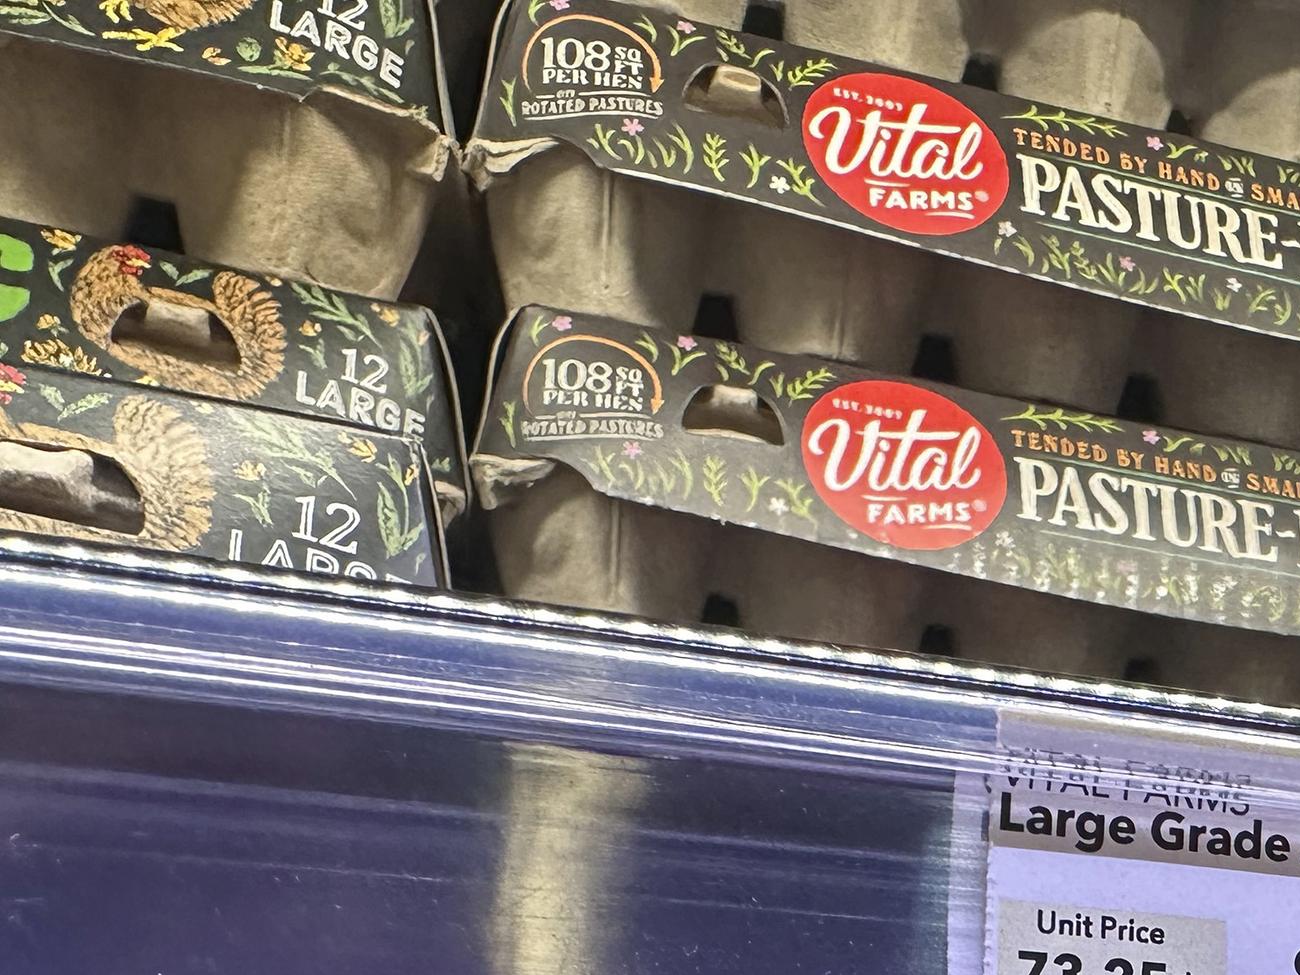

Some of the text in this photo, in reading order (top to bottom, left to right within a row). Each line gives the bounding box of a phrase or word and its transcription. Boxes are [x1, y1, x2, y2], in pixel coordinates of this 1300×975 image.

[270, 0, 405, 89] LARGE
[541, 37, 642, 72] 108 SQ
[614, 60, 643, 75] FT
[542, 69, 643, 89] PER HEN
[521, 96, 664, 116] ROTATED PASTURES
[808, 103, 984, 181] Vital
[1013, 127, 1110, 165] TENDED
[1120, 152, 1148, 174] BY
[1158, 161, 1220, 191] HAND
[341, 348, 390, 394] 12
[542, 358, 643, 393] 108 SQ
[295, 370, 427, 440] LARGE
[543, 390, 589, 407] PER
[808, 409, 982, 492] Vital
[1011, 429, 1108, 462] TENDED
[1116, 448, 1145, 470] BY
[1154, 456, 1217, 483] HAND
[292, 496, 361, 555] 12
[1000, 792, 1136, 853] Large
[1151, 811, 1290, 863] Grade
[1037, 909, 1165, 945] Unit Price
